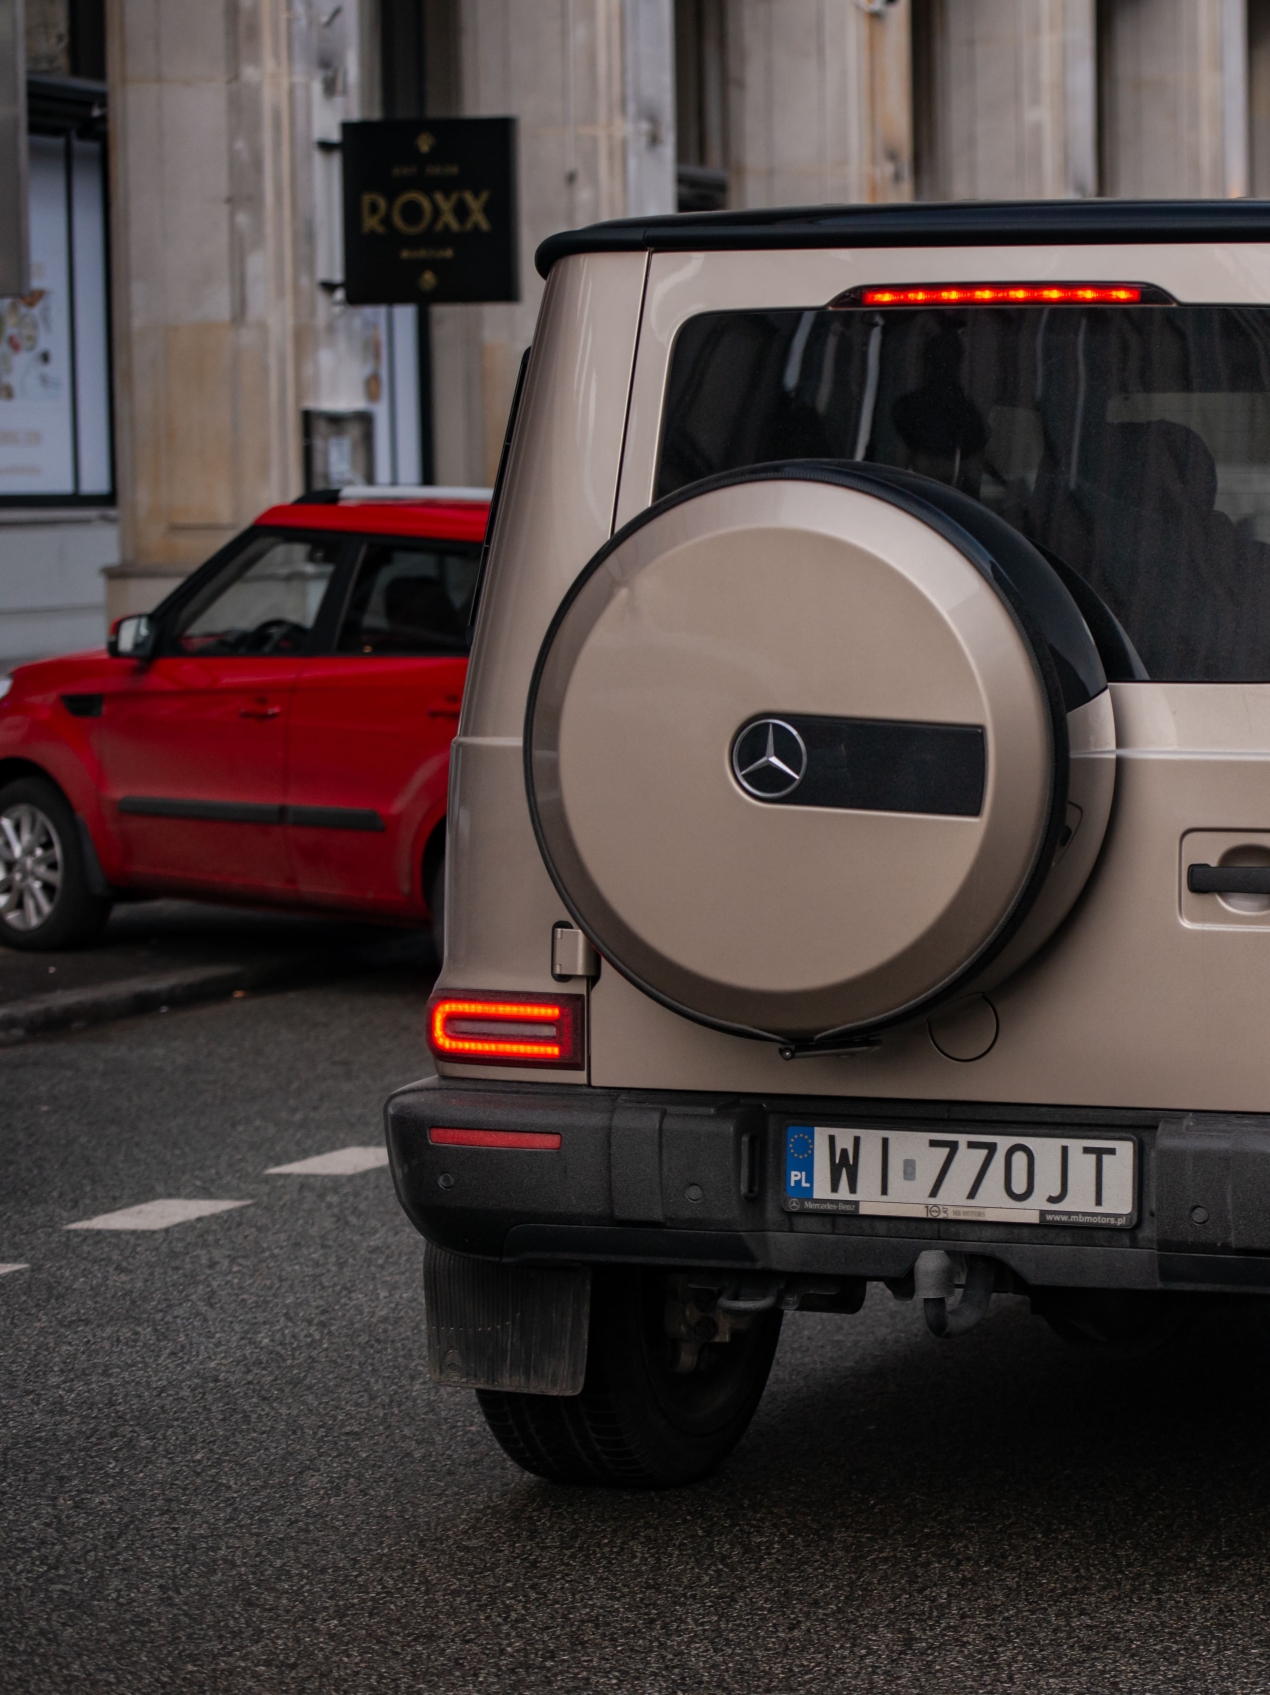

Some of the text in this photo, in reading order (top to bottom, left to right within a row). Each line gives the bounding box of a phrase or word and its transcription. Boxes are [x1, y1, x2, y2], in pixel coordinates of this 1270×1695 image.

[361, 189, 491, 235] ROXX
[828, 1134, 1116, 1207] WI 770JT
[790, 1171, 810, 1187] PL
[804, 1201, 856, 1211] Mercedes-Benz
[1046, 1214, 1126, 1226] www.mbmotors.pl
